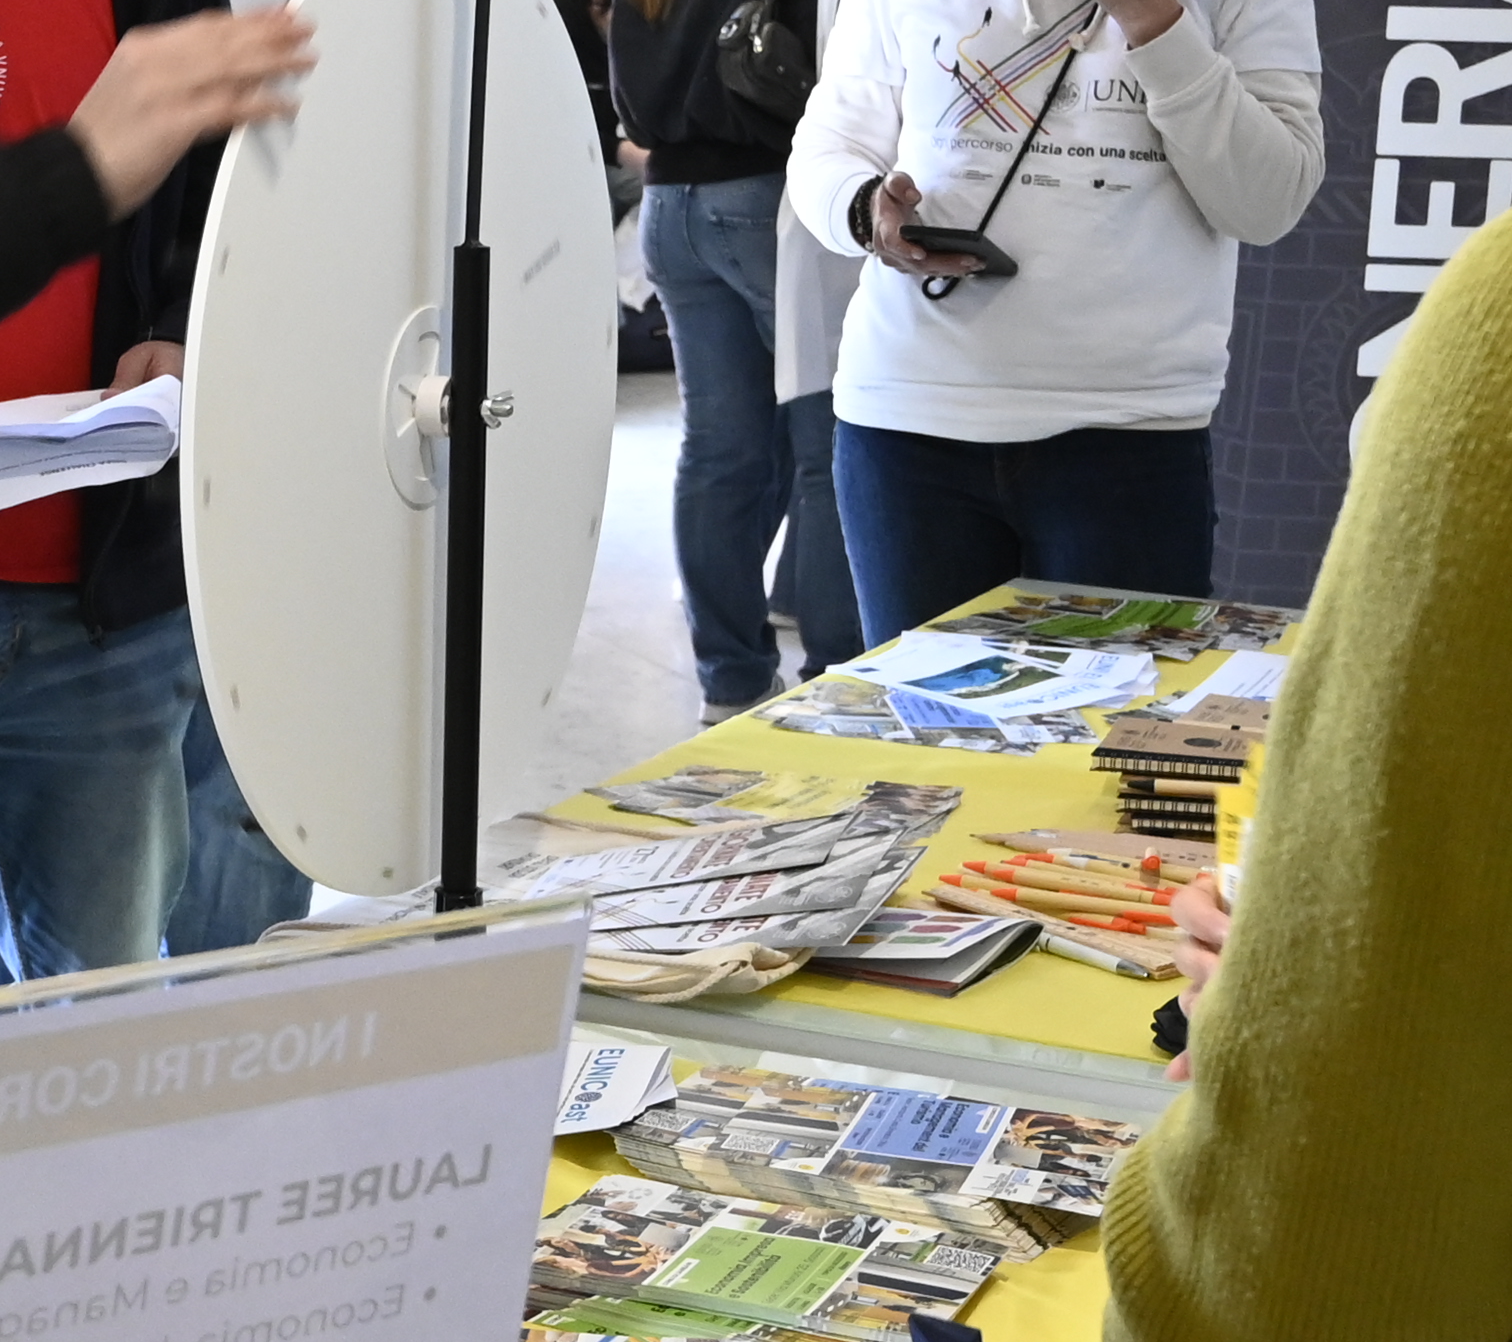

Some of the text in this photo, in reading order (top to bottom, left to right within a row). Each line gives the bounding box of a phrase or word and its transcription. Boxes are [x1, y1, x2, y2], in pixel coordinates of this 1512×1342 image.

[950, 137, 1013, 153] percorso
[1067, 145, 1094, 158] con
[1099, 147, 1126, 159] una
